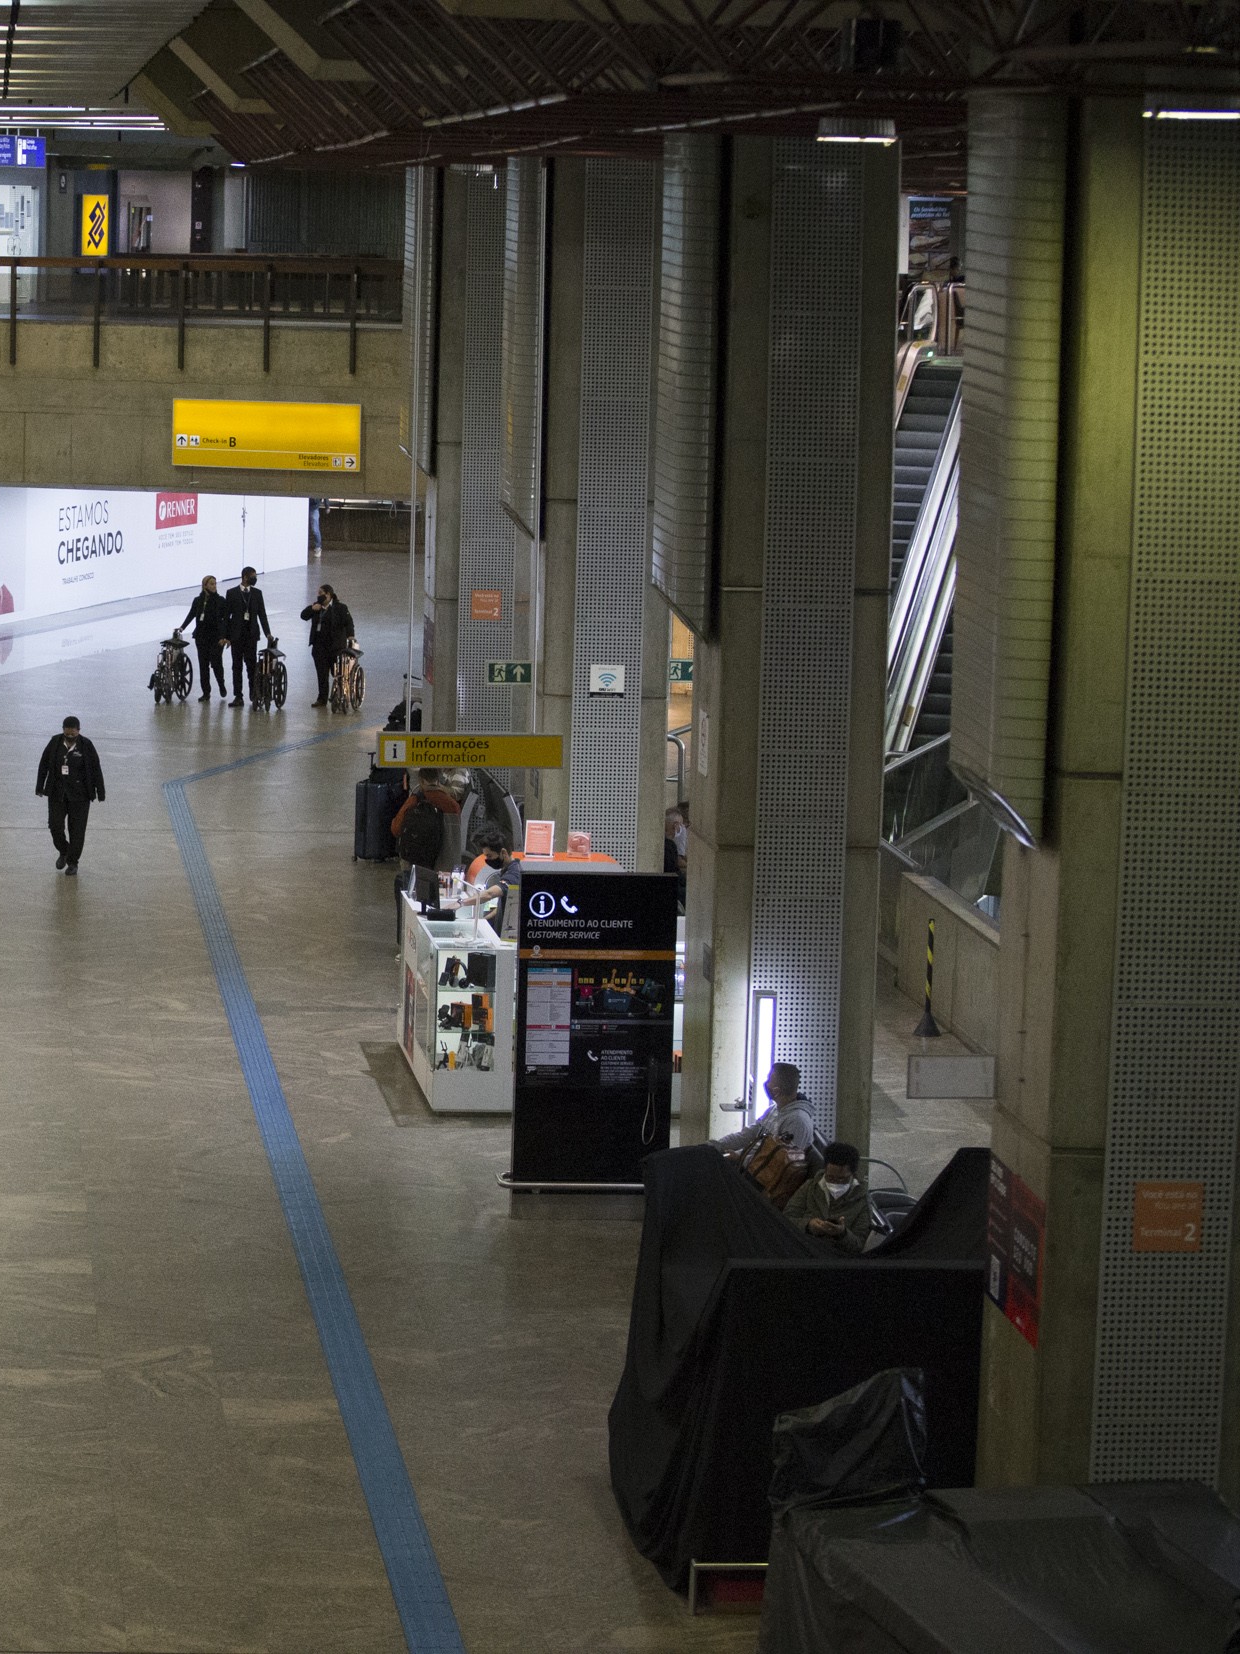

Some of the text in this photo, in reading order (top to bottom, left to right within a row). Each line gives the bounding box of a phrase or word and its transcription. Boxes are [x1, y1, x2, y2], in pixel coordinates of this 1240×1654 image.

[229, 437, 237, 447] B
[298, 453, 329, 461] Elevadores
[166, 498, 196, 519] RENNER
[59, 500, 109, 532] ESTAMOS
[57, 530, 124, 565] CHEGANDO.
[493, 607, 499, 616] 2
[411, 738, 490, 752] Informações
[411, 752, 486, 763] Information
[527, 919, 633, 929] ATENDIMENTO AO CLIENTE
[527, 930, 601, 940] CUSTOMER SERVICE
[1184, 1223, 1196, 1242] 2
